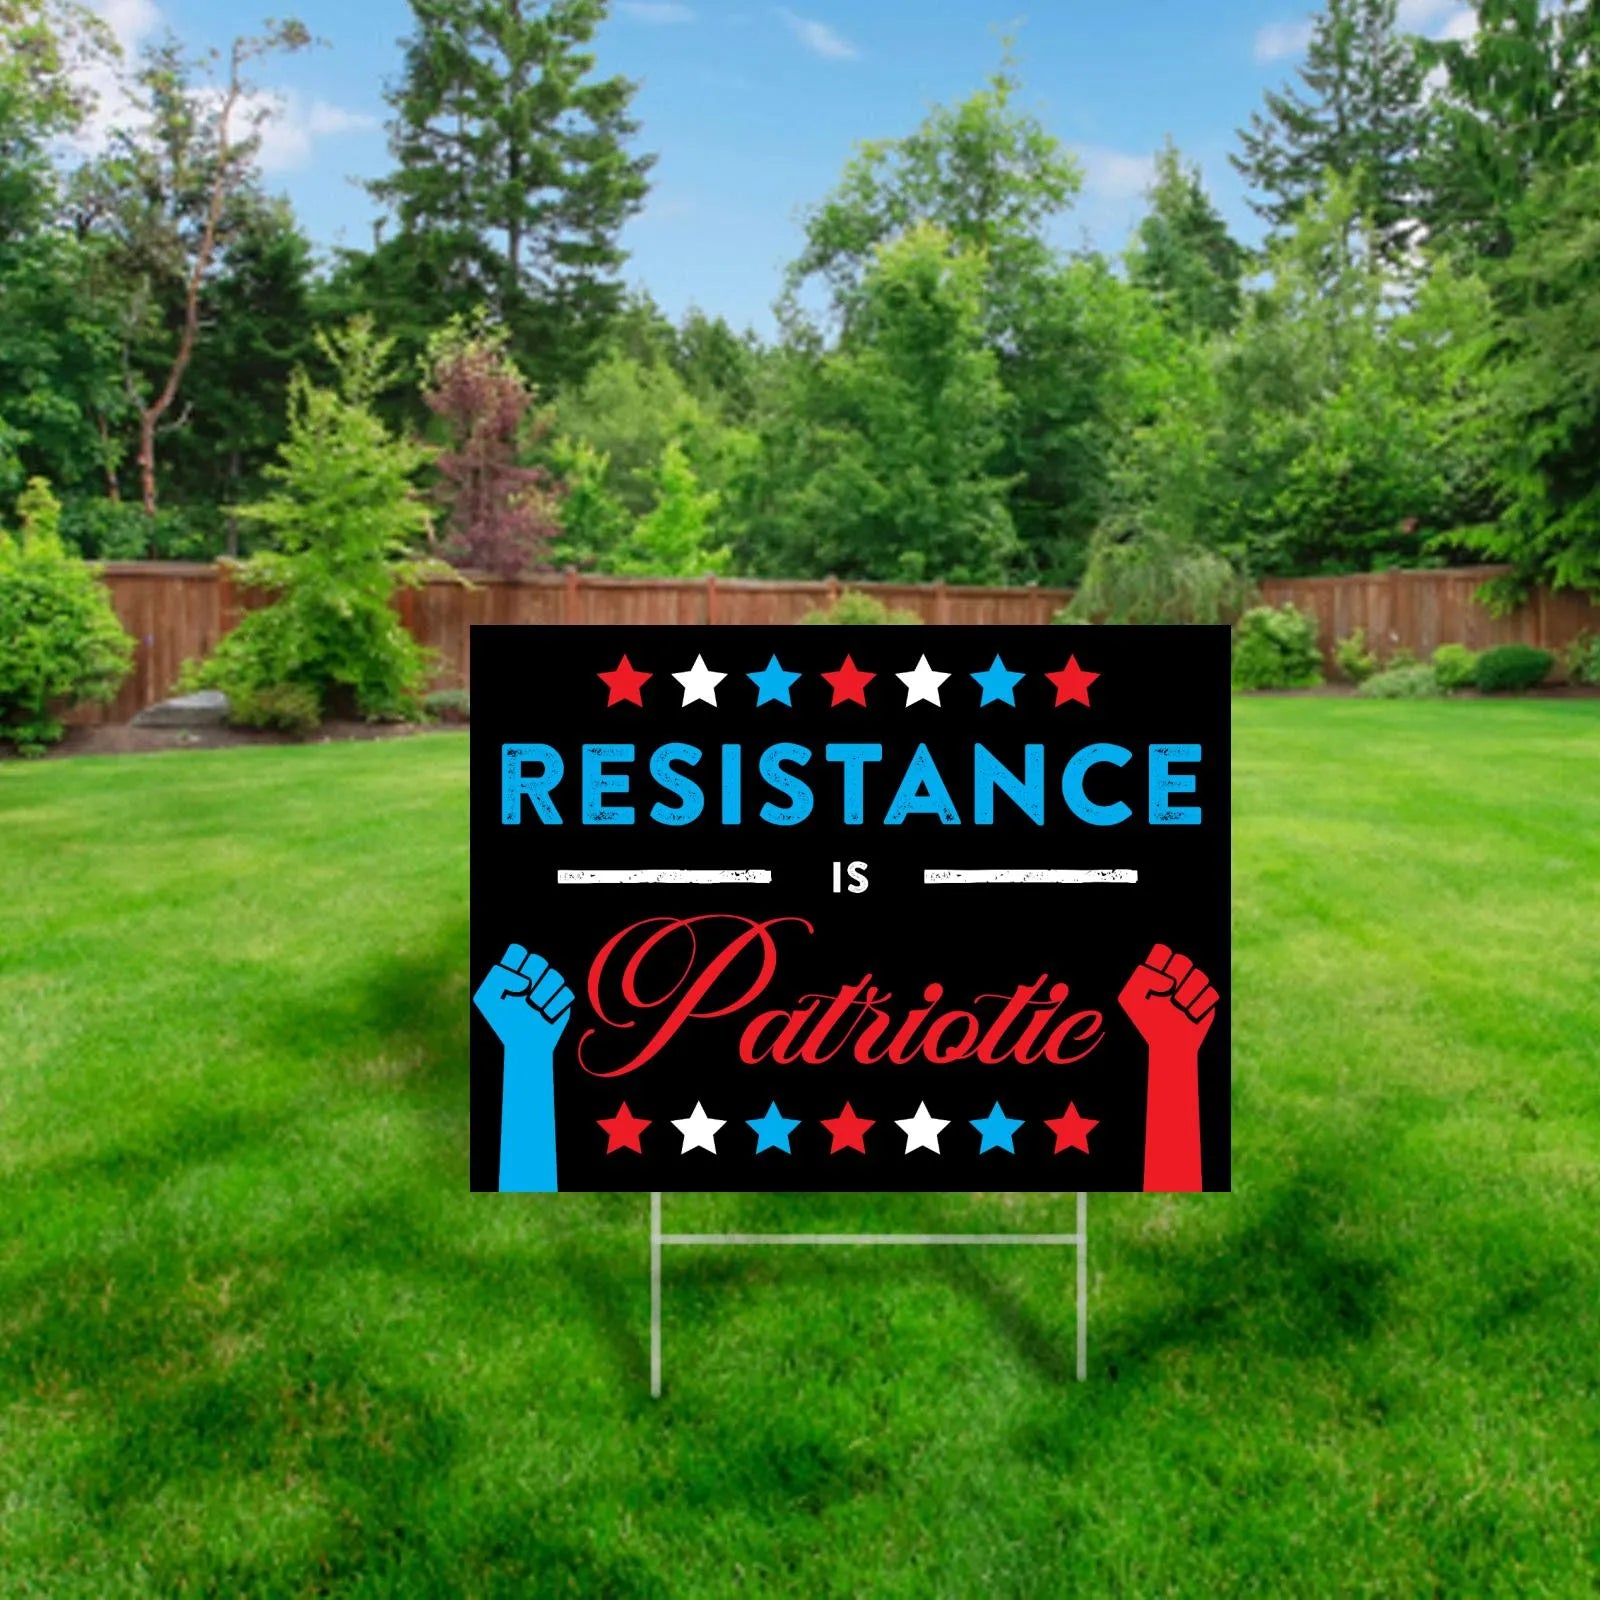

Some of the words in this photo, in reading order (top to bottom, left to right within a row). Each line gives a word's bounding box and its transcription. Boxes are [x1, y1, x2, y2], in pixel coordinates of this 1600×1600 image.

[501, 742, 1202, 827] RESISTANCE
[832, 860, 869, 894] IS
[577, 914, 1105, 1078] Patriotic
